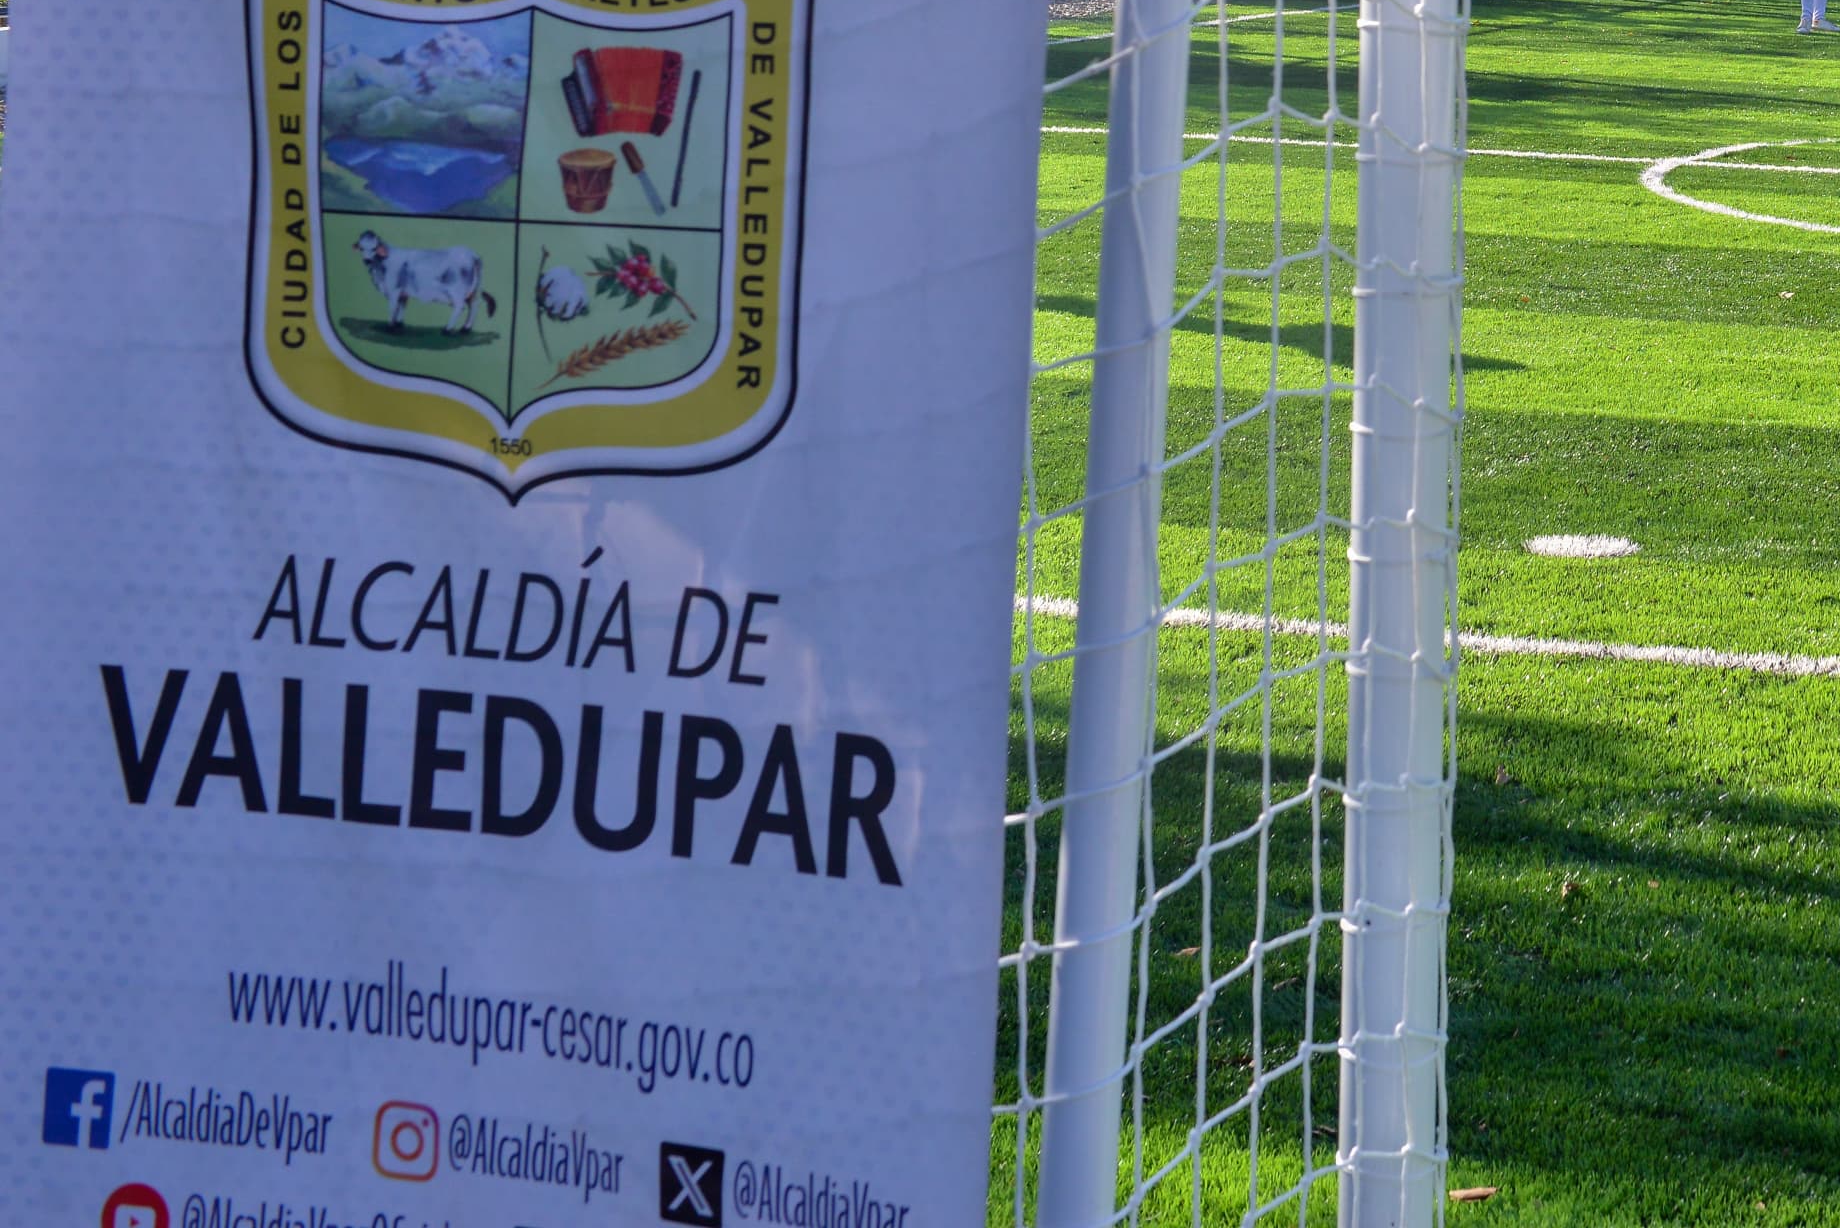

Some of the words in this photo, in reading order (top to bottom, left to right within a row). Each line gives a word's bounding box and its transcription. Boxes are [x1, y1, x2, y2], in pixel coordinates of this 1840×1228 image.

[277, 9, 303, 91] LOS
[750, 21, 777, 75] DE
[279, 114, 302, 167] DE
[280, 187, 309, 349] CIUDAD
[735, 98, 774, 391] VALLEDUPAR
[489, 436, 533, 457] 1550
[253, 546, 637, 673] ALCALDÍA
[666, 585, 781, 687] DE
[99, 664, 904, 887] VALLEDUPAR
[227, 959, 756, 1095] www.valledupar-cesar.gov.co
[448, 1113, 624, 1205] @AlcaldiaVpar
